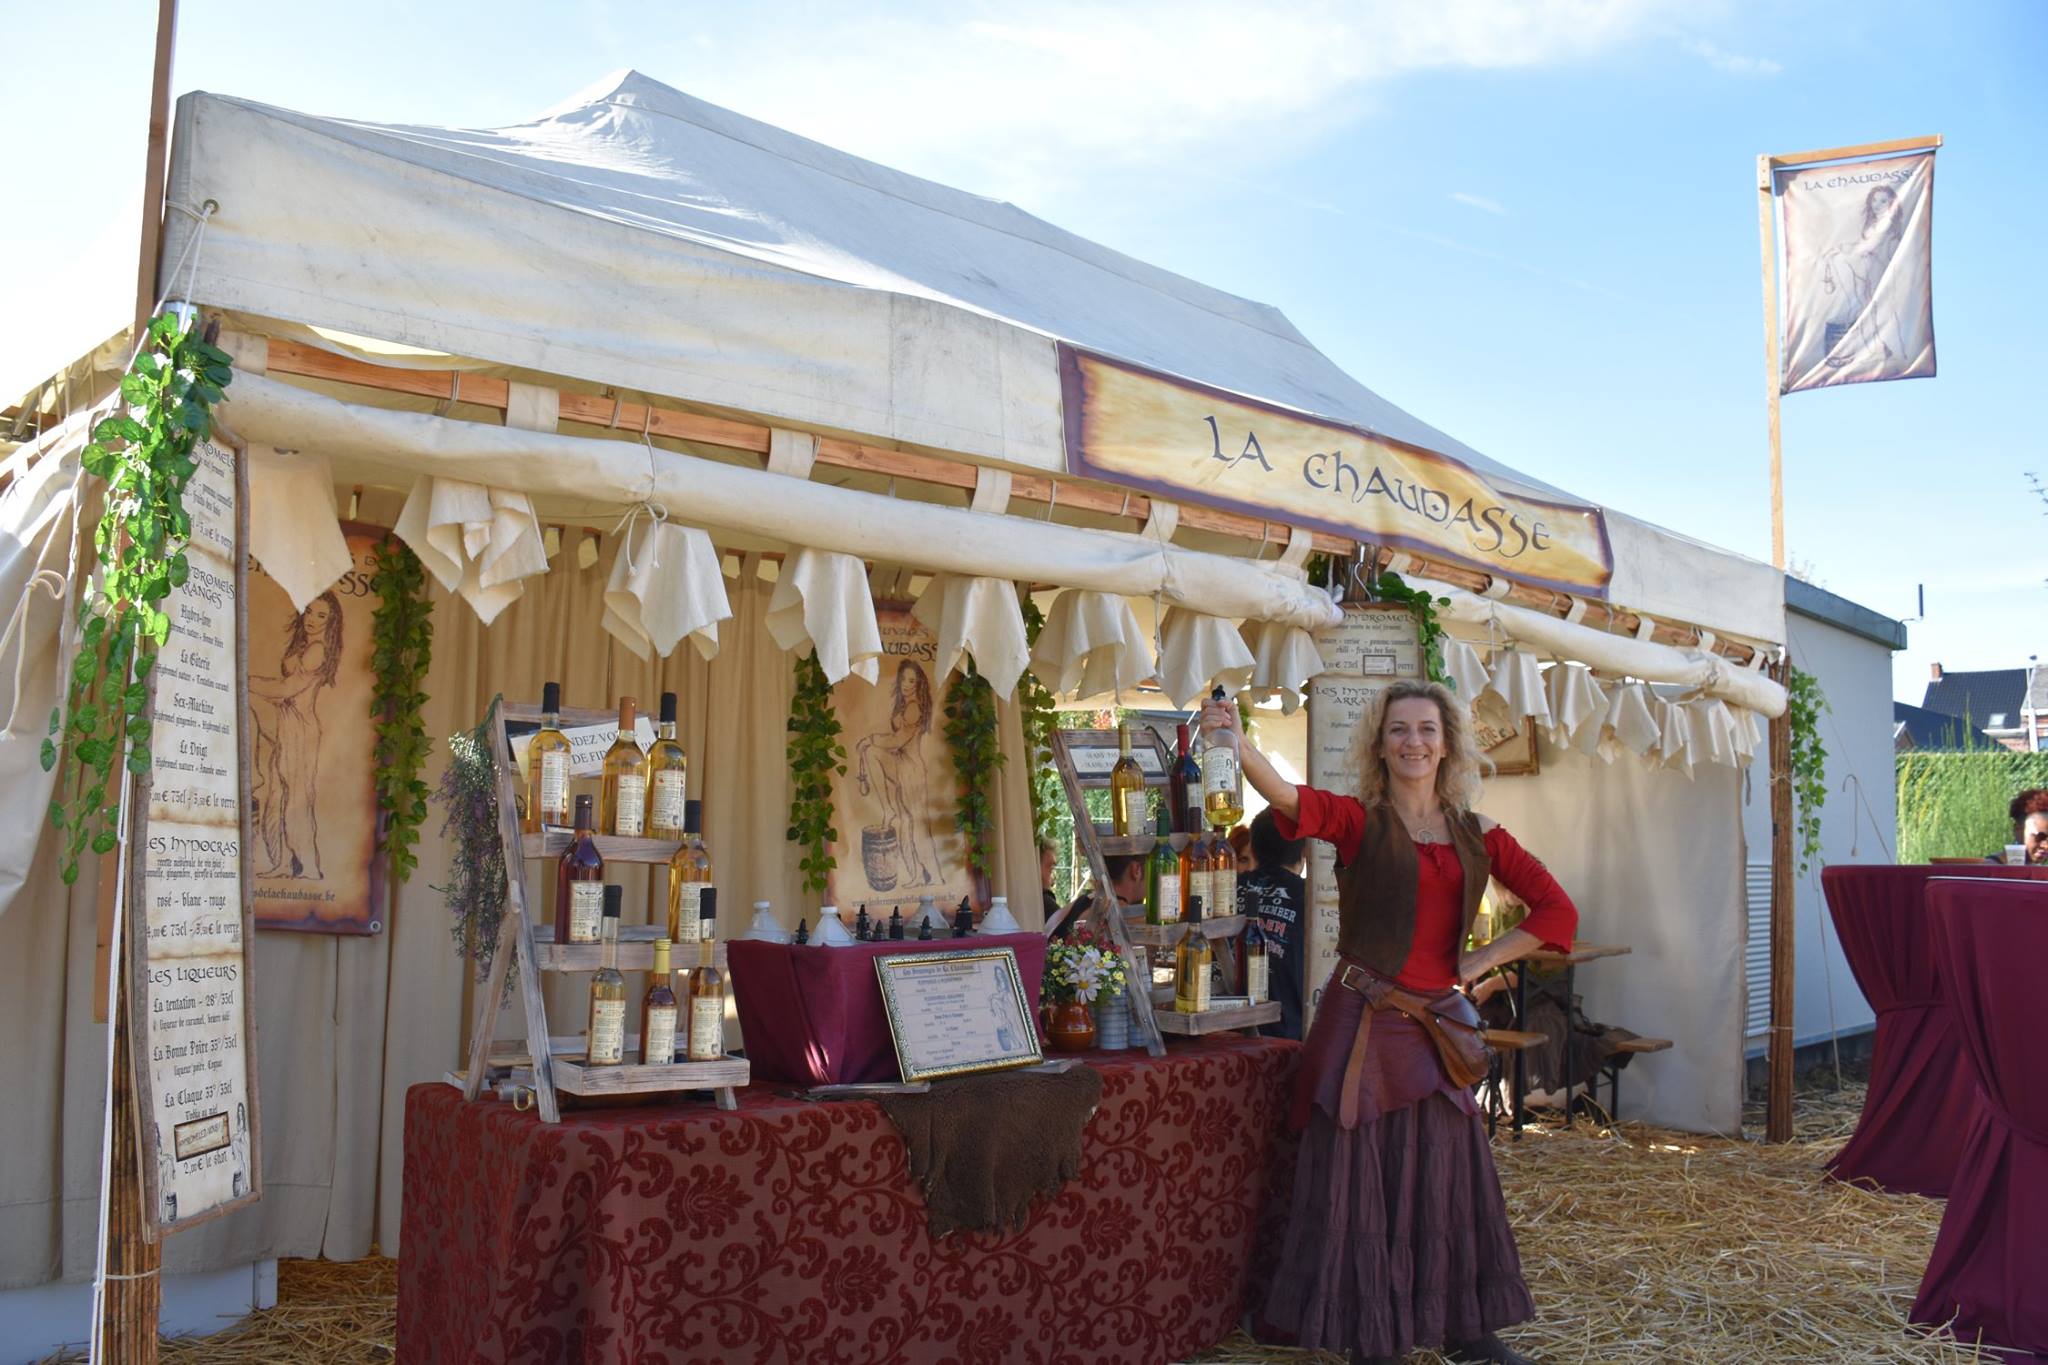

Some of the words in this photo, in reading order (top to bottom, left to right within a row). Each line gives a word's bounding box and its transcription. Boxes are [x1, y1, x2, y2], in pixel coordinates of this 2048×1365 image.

[1803, 179, 1823, 191] LA
[1203, 415, 1273, 472] LA
[1302, 449, 1551, 558] CHAUDASSE
[157, 890, 172, 908] rosé
[182, 890, 202, 907] blanc
[147, 968, 172, 988] LES
[177, 964, 237, 984] LIQUEURS
[153, 998, 164, 1013] La
[153, 1046, 164, 1062] La
[165, 1092, 176, 1108] La
